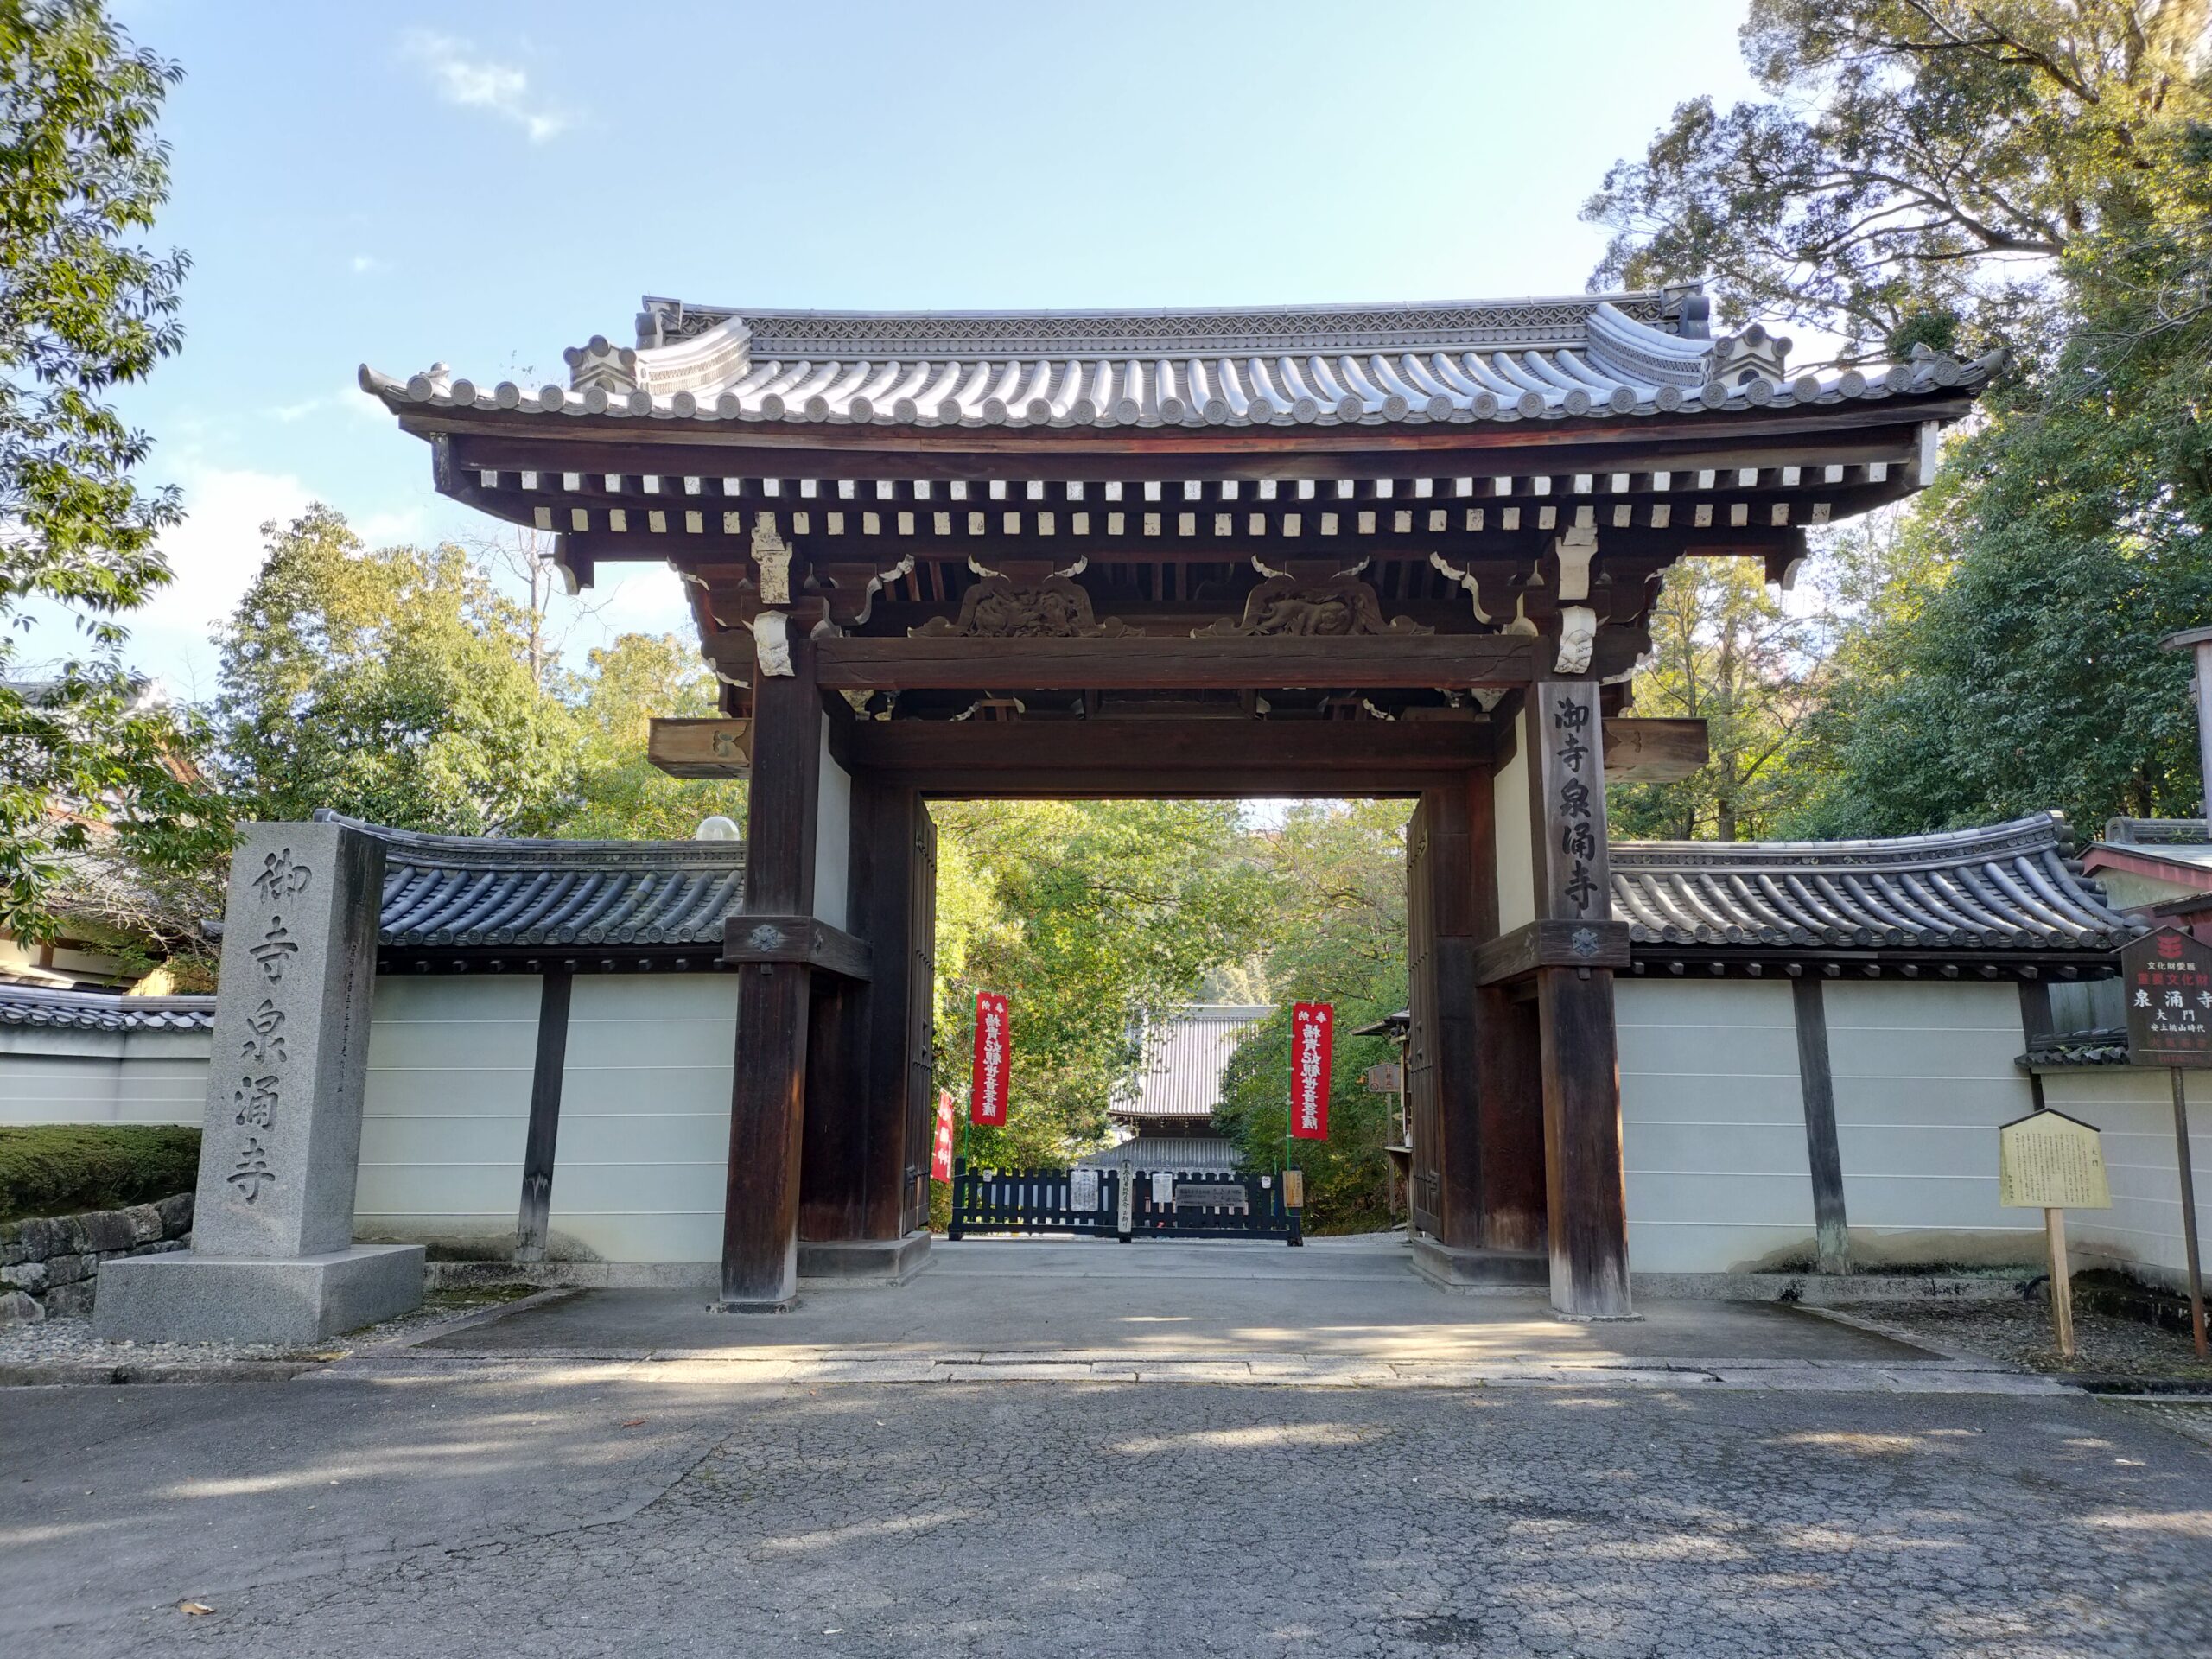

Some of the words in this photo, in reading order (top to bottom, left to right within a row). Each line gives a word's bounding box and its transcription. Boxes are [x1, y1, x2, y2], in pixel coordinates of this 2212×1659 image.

[1555, 696, 1598, 911] 御寺泉涌寺
[2137, 973, 2209, 986] 重要文化財
[2133, 988, 2212, 1009] 泉涌寺
[2156, 1009, 2196, 1021] 大門
[226, 848, 312, 1205] 御寺泉涌寺
[2151, 1023, 2206, 1033] 安土桃山時代
